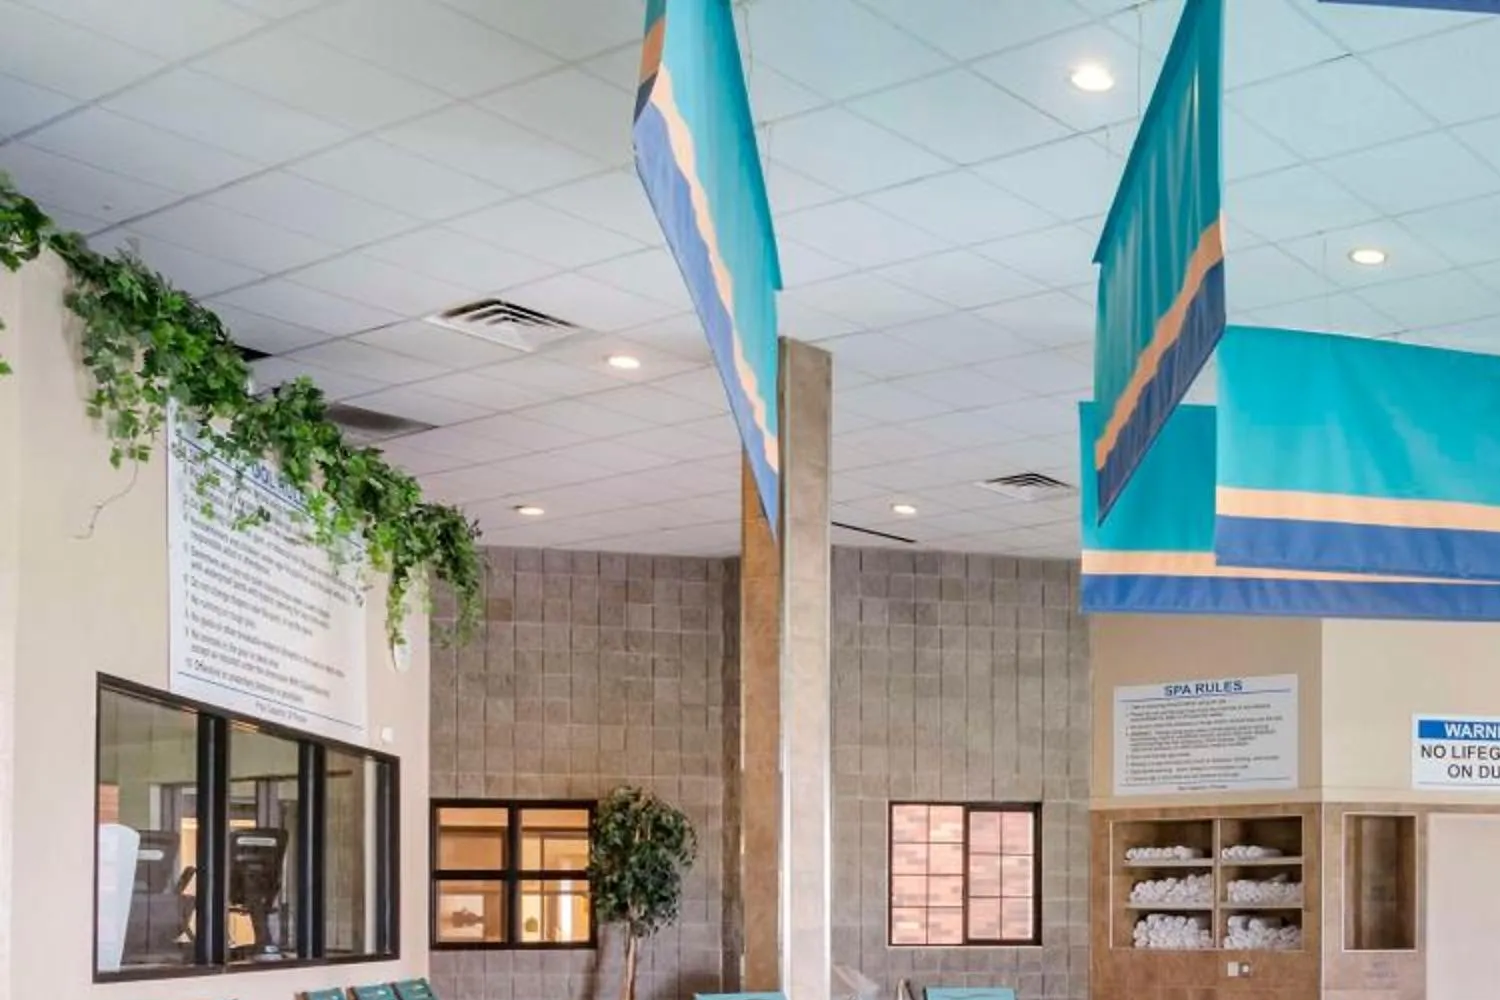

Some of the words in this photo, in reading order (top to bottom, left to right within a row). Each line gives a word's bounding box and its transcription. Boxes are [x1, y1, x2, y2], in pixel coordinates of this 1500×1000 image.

[1164, 684, 1191, 696] SPA
[1196, 680, 1243, 694] RULES
[1421, 745, 1446, 759] NO
[1447, 764, 1472, 778] ON
